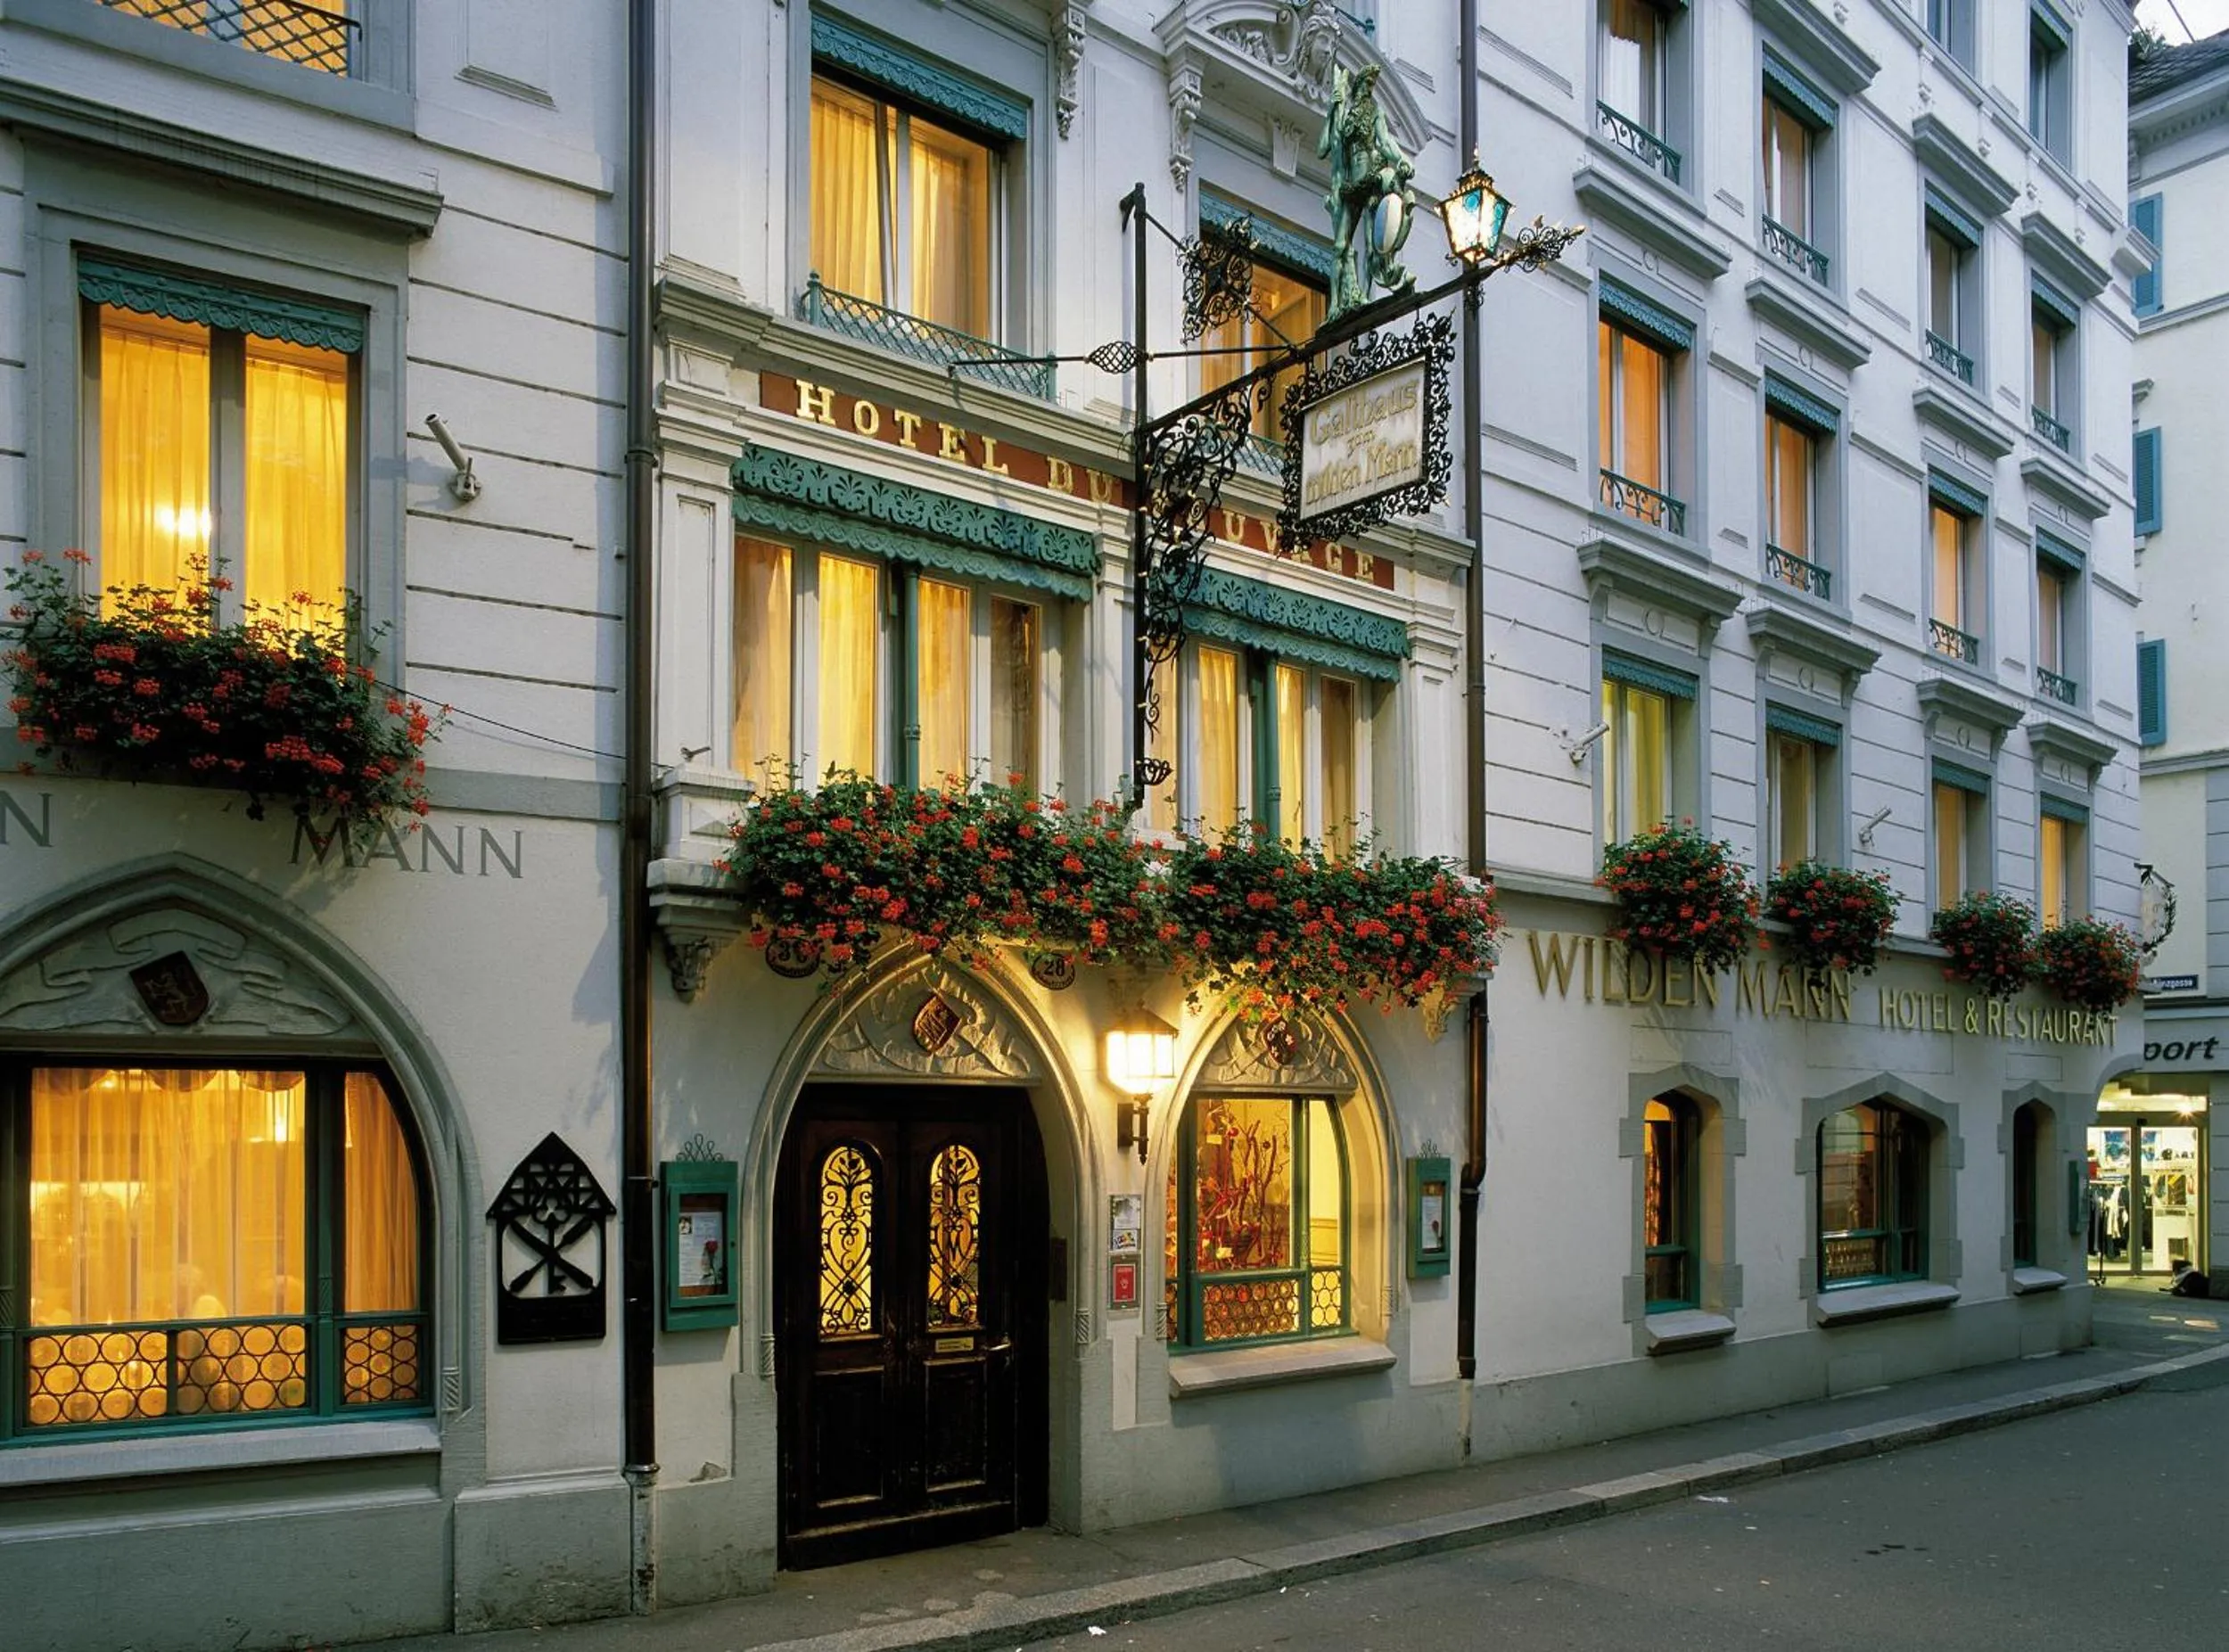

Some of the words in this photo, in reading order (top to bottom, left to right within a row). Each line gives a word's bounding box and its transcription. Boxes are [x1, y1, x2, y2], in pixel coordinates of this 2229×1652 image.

[796, 379, 1008, 475] HOTEL
[1047, 456, 1114, 504] DU
[287, 812, 523, 879] MANN
[1527, 930, 1719, 1009] WILDEN
[1737, 959, 1852, 1021] MANN
[1879, 986, 1958, 1032] HOTEL
[1965, 998, 1980, 1034] &
[1987, 996, 2119, 1047] RESTAURANT
[2143, 1036, 2220, 1061] port
